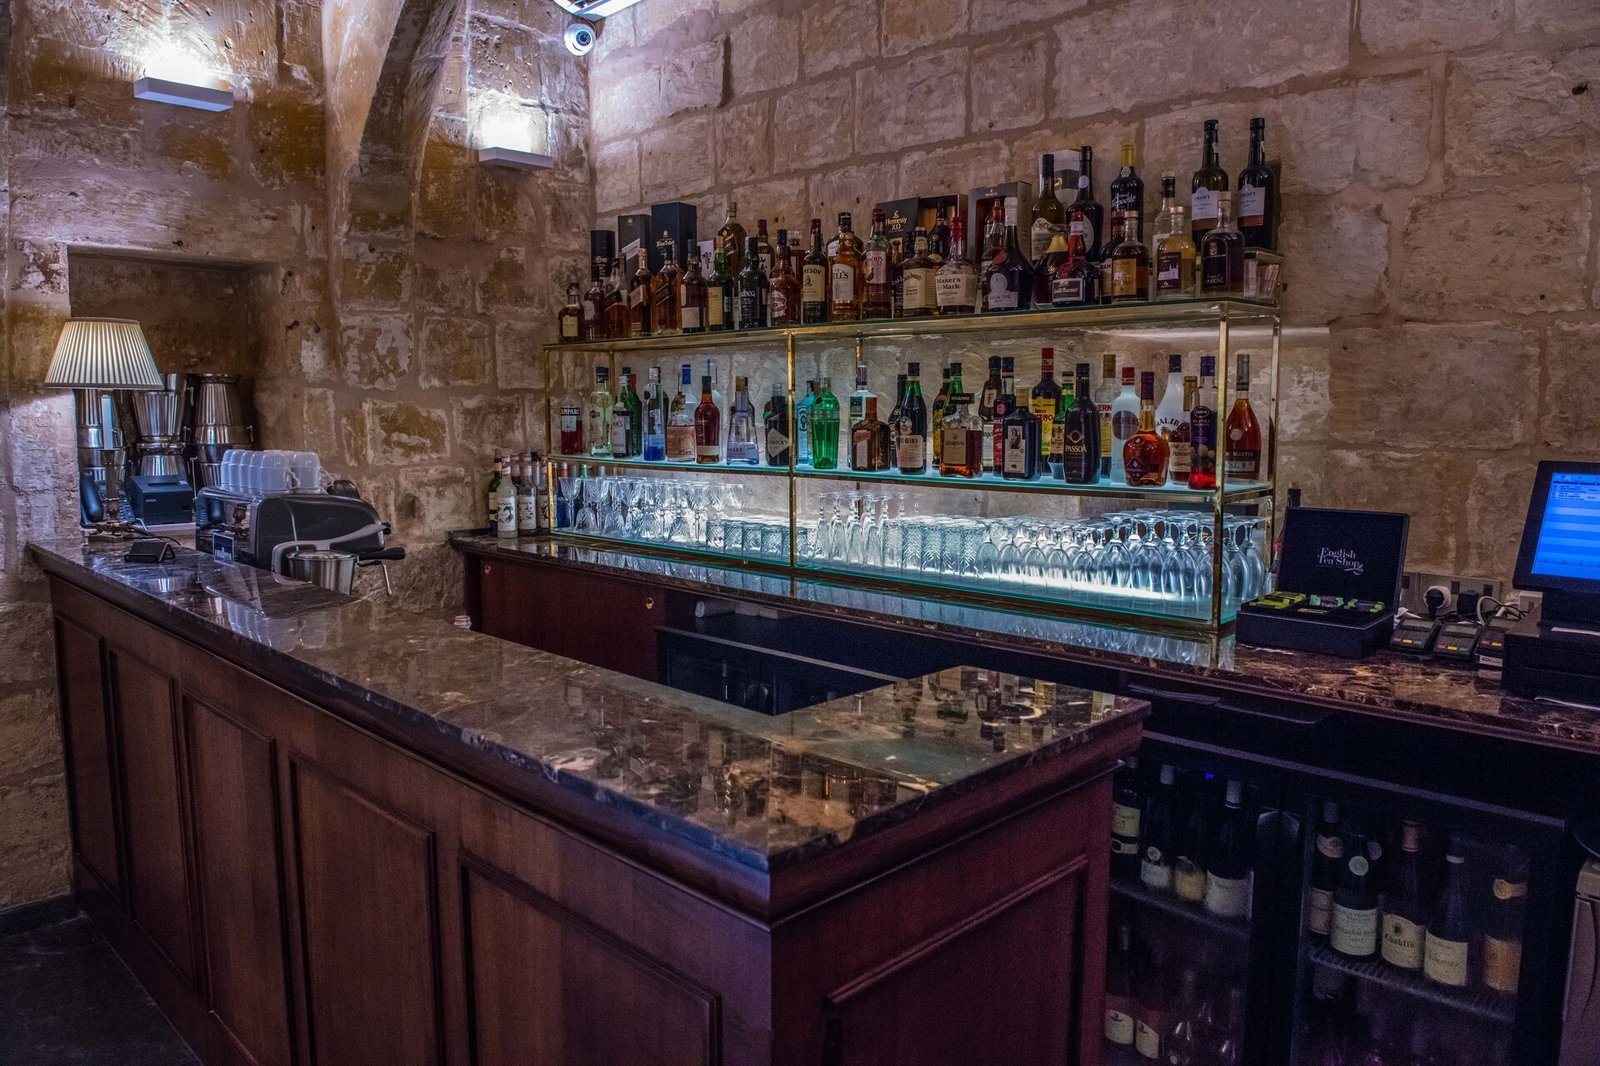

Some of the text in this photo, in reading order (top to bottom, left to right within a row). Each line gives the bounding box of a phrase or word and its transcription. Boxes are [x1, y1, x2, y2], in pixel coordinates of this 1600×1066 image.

[1319, 547, 1357, 560] English
[1317, 555, 1363, 574] Tea Shop
